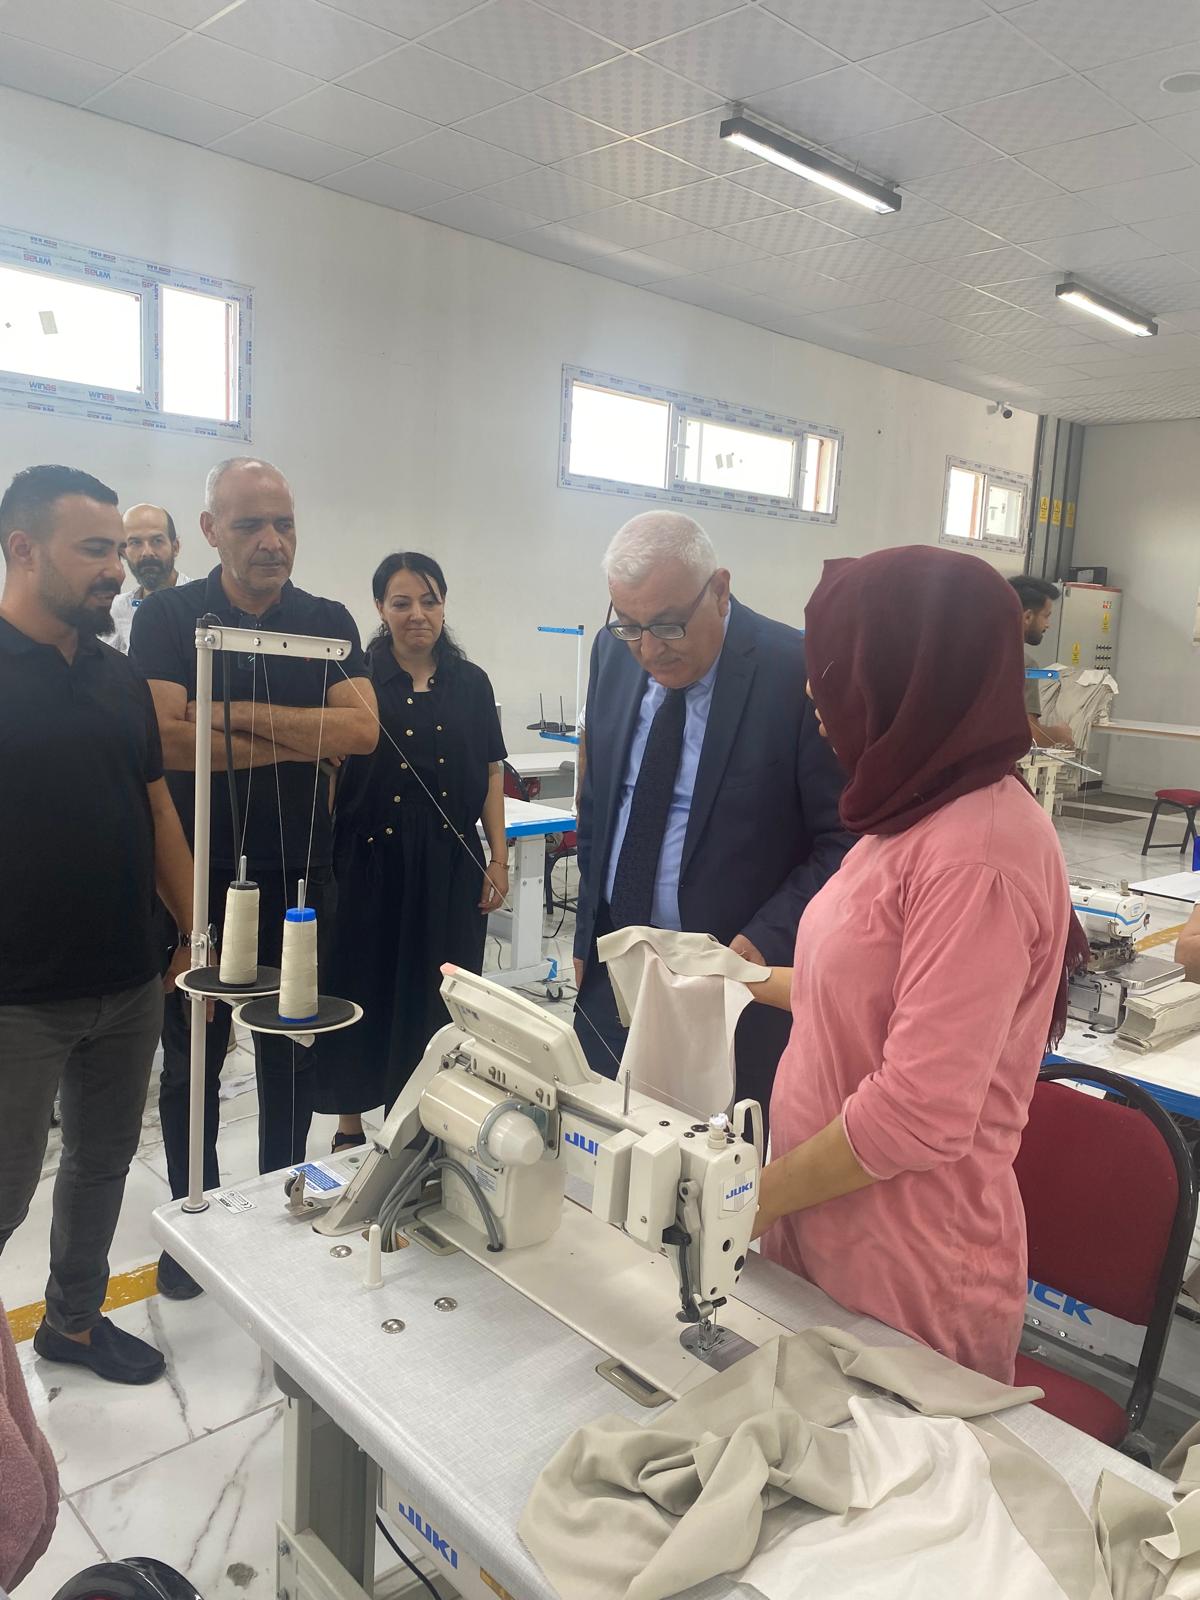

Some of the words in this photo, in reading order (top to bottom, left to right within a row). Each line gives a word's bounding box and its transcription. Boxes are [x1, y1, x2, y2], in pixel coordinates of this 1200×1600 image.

[725, 1181, 753, 1200] JUKI
[1028, 1279, 1095, 1326] CK
[398, 1502, 458, 1570] JUKI
